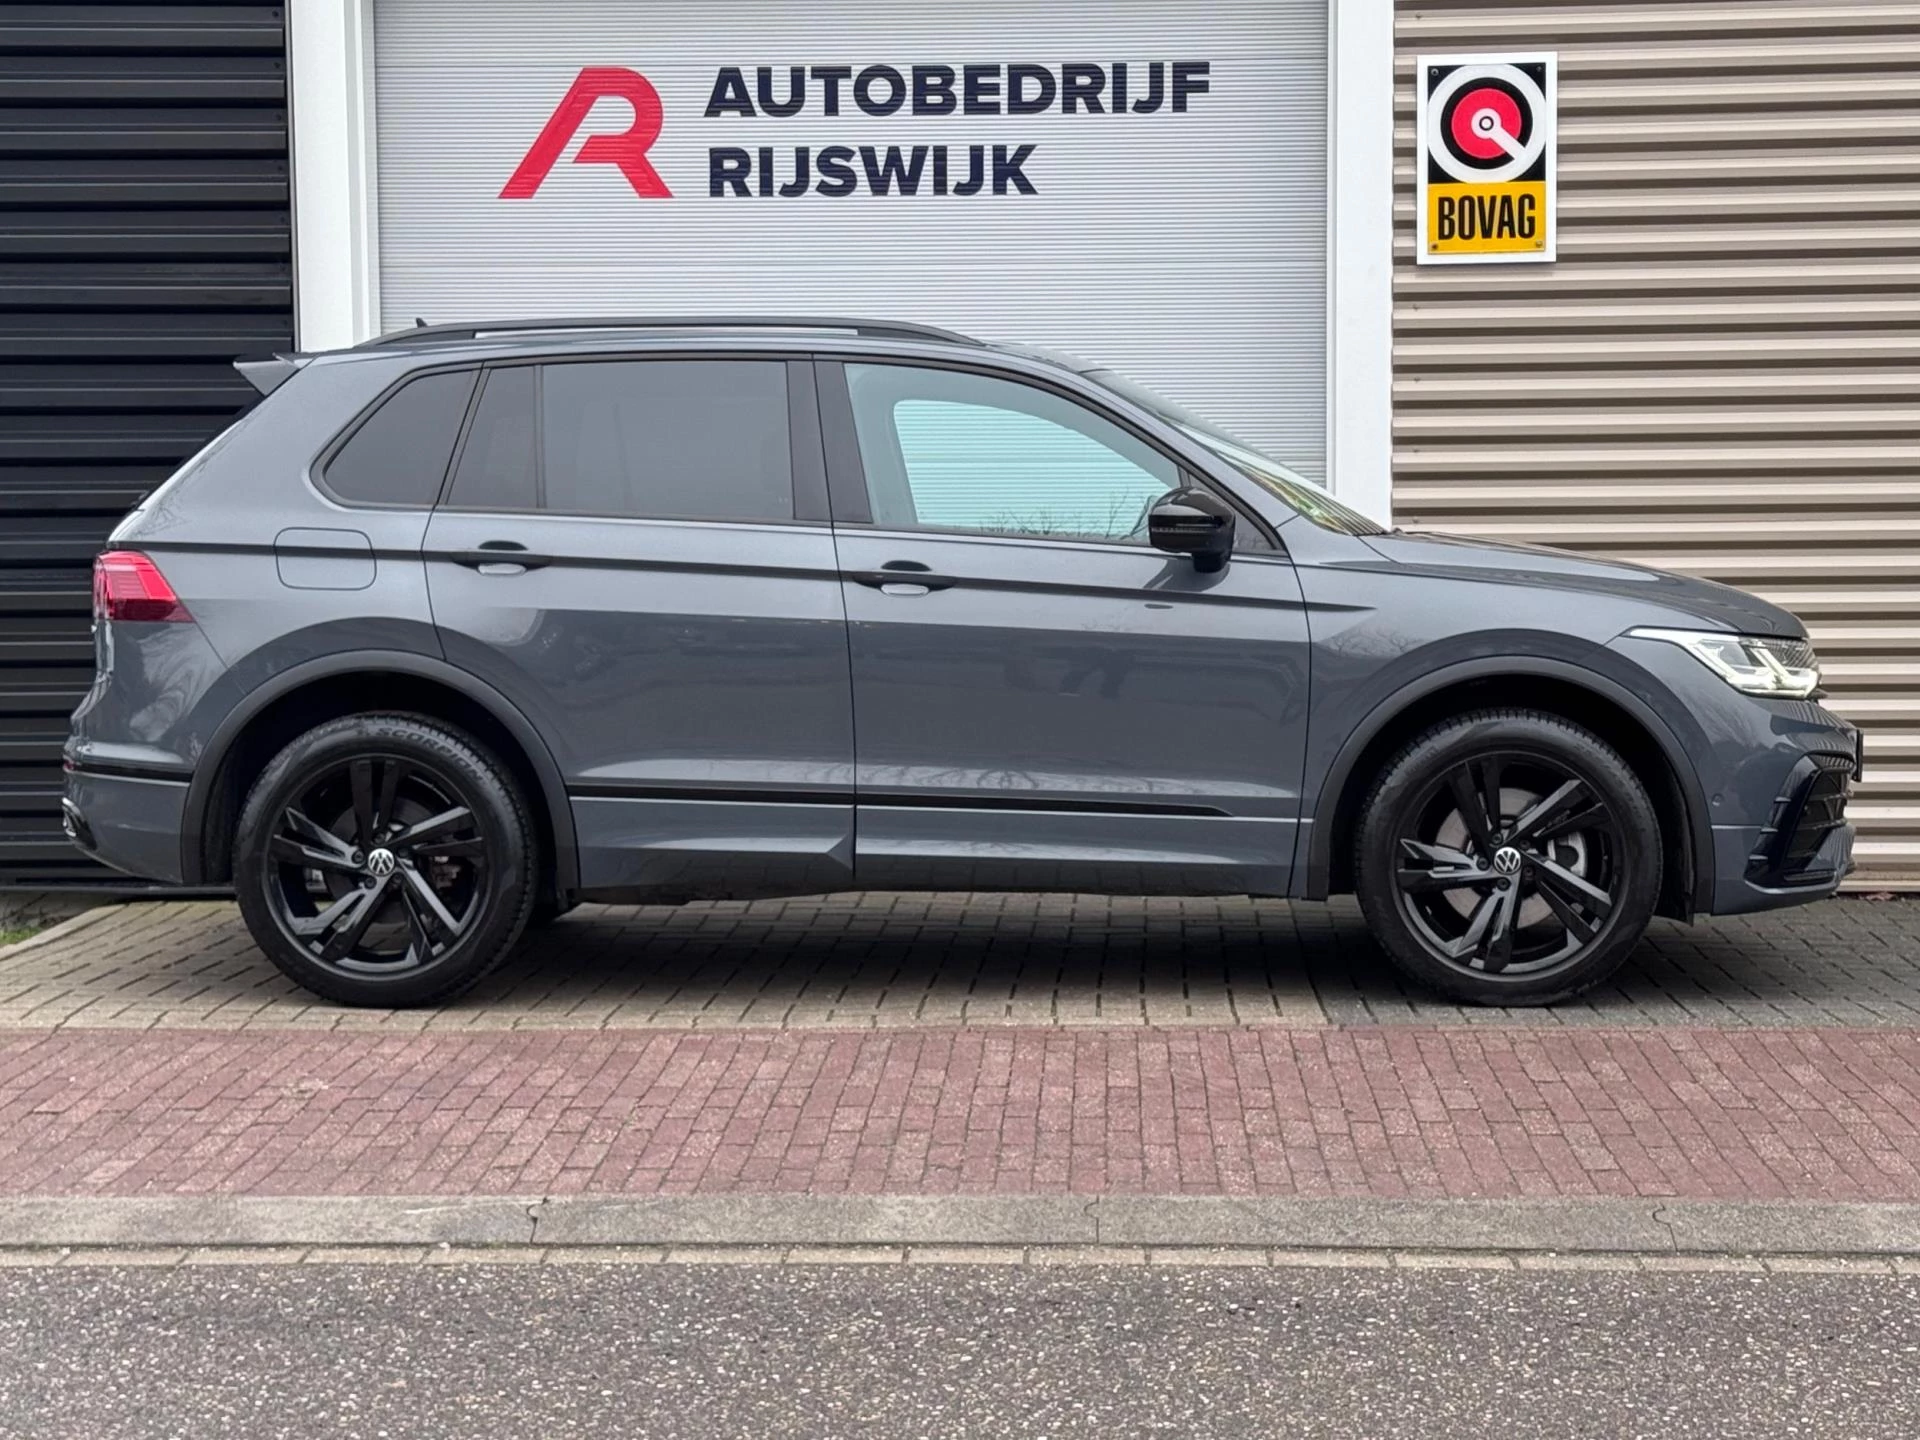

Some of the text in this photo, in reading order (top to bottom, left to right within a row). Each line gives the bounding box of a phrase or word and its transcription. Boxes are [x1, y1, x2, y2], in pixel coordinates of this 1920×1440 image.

[704, 62, 1209, 117] AUTOBEDRIJF
[709, 145, 1037, 197] RIJSWIJK
[1438, 194, 1535, 240] BOVAG
